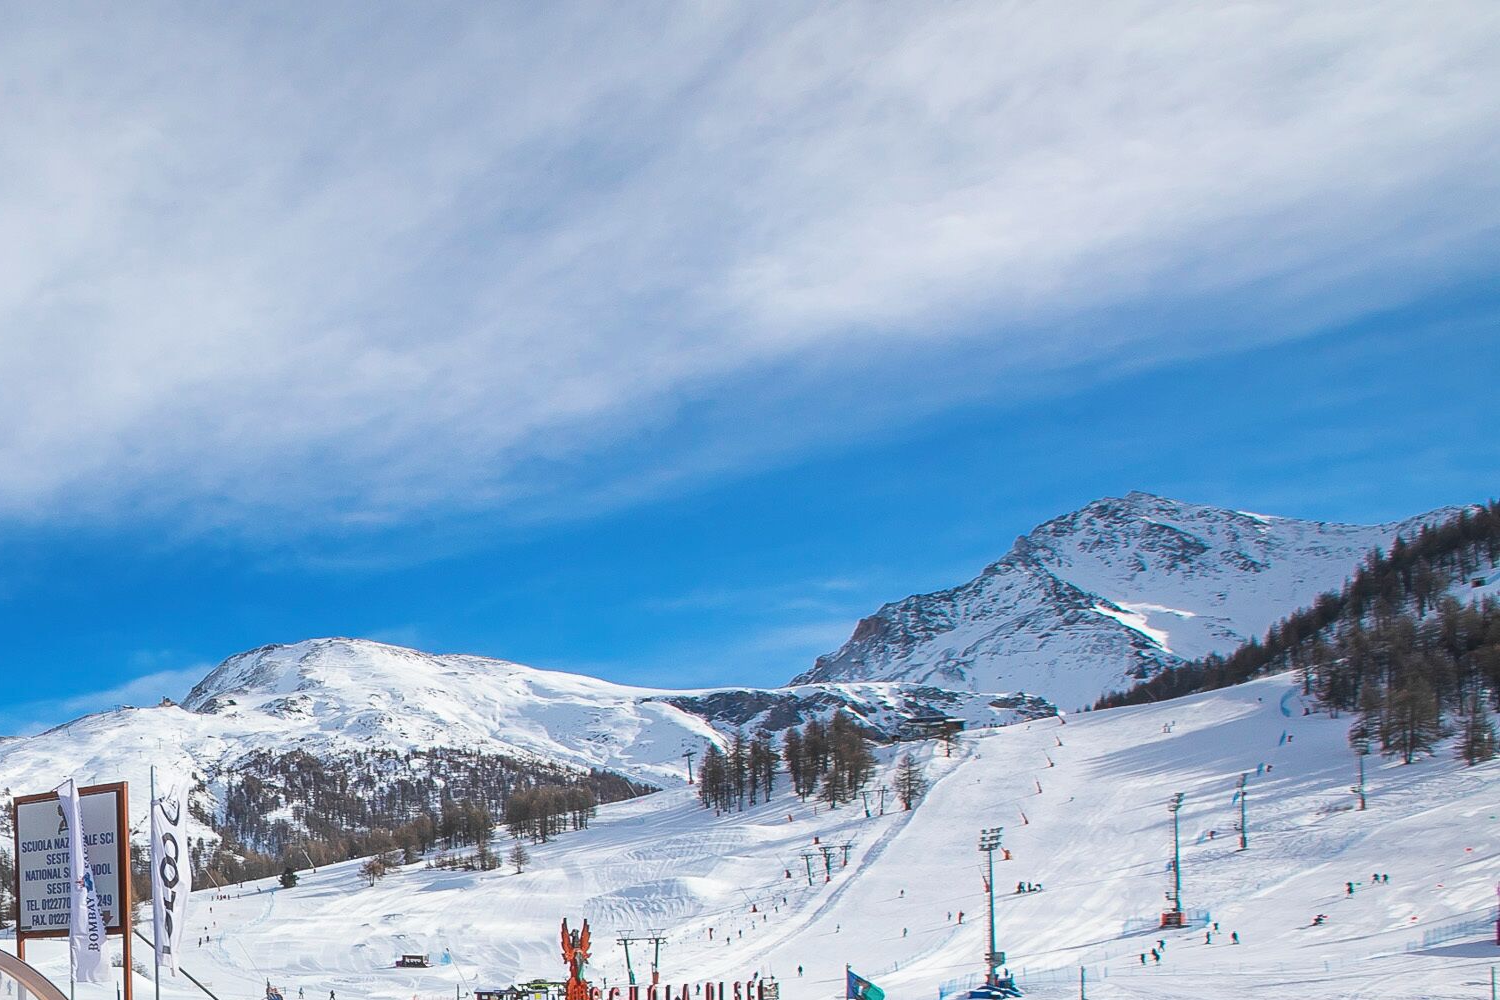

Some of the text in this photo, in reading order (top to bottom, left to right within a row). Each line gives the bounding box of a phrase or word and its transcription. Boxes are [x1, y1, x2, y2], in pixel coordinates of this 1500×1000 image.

[21, 832, 114, 853] SCUOLA NAZALE SCI
[25, 868, 62, 882] NATIONAL
[87, 897, 101, 952] BOMBAY
